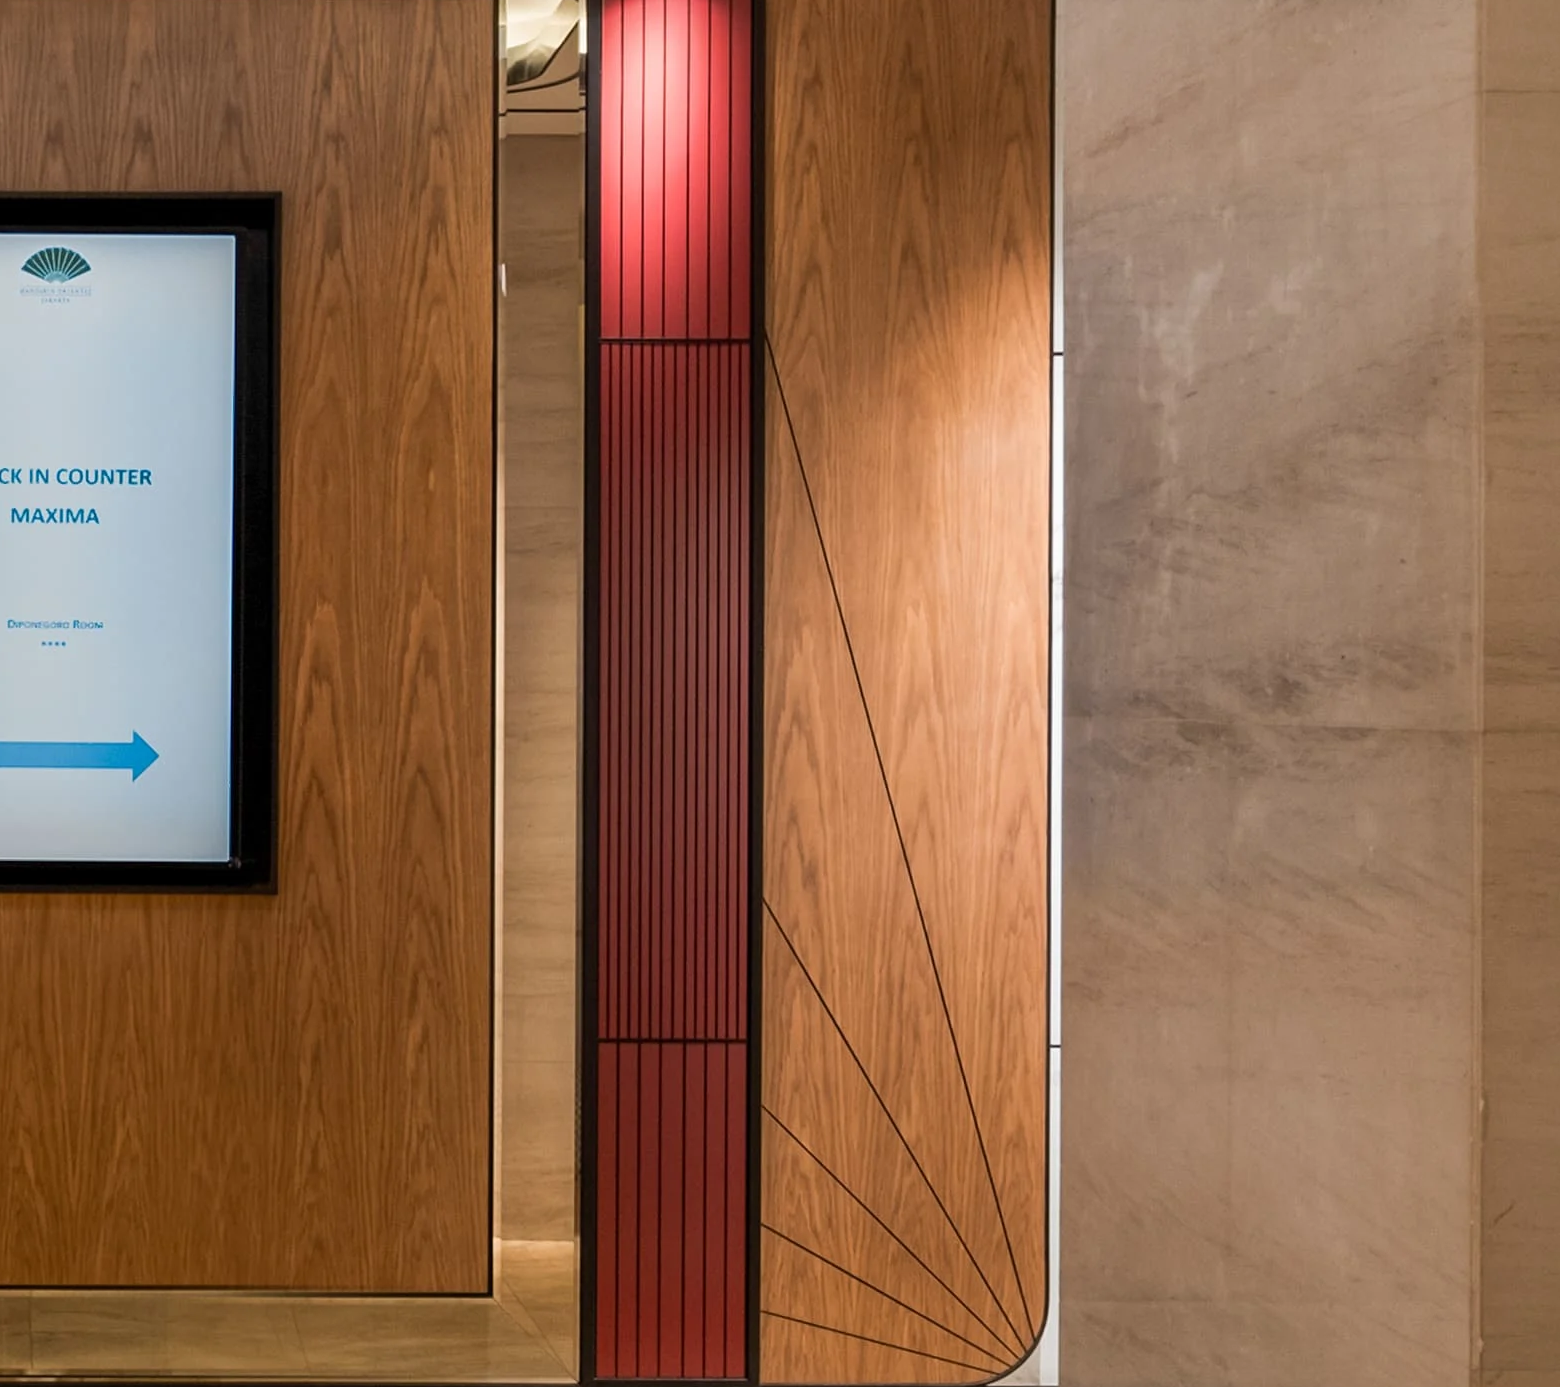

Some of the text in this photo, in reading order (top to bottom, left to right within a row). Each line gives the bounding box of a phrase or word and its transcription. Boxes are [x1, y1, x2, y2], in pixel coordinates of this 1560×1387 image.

[29, 468, 50, 484] IN
[56, 468, 153, 486] COUNTER
[10, 507, 100, 525] MAXIMA
